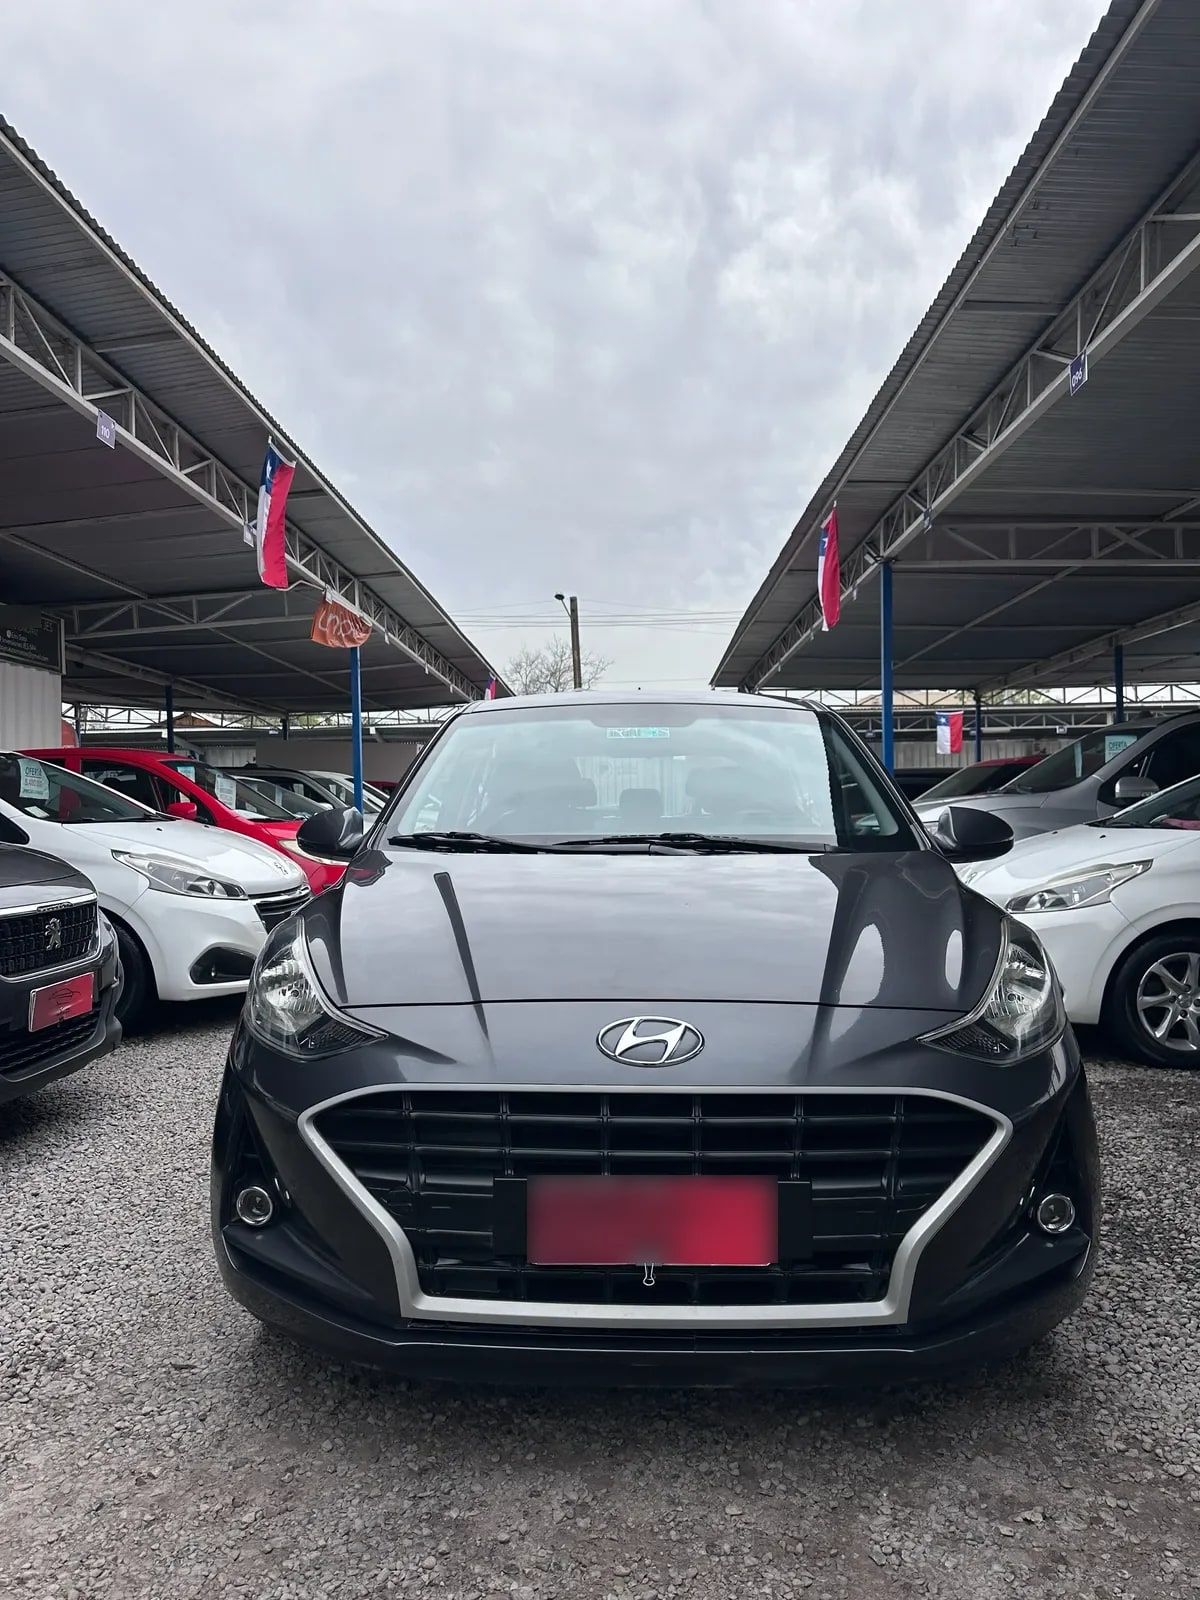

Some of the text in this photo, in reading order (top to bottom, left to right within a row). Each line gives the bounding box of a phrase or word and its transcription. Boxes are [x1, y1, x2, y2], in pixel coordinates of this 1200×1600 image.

[1071, 367, 1083, 388] 096
[101, 425, 110, 439] 110
[1108, 741, 1127, 750] OFERTA
[25, 766, 43, 776] OFERTA
